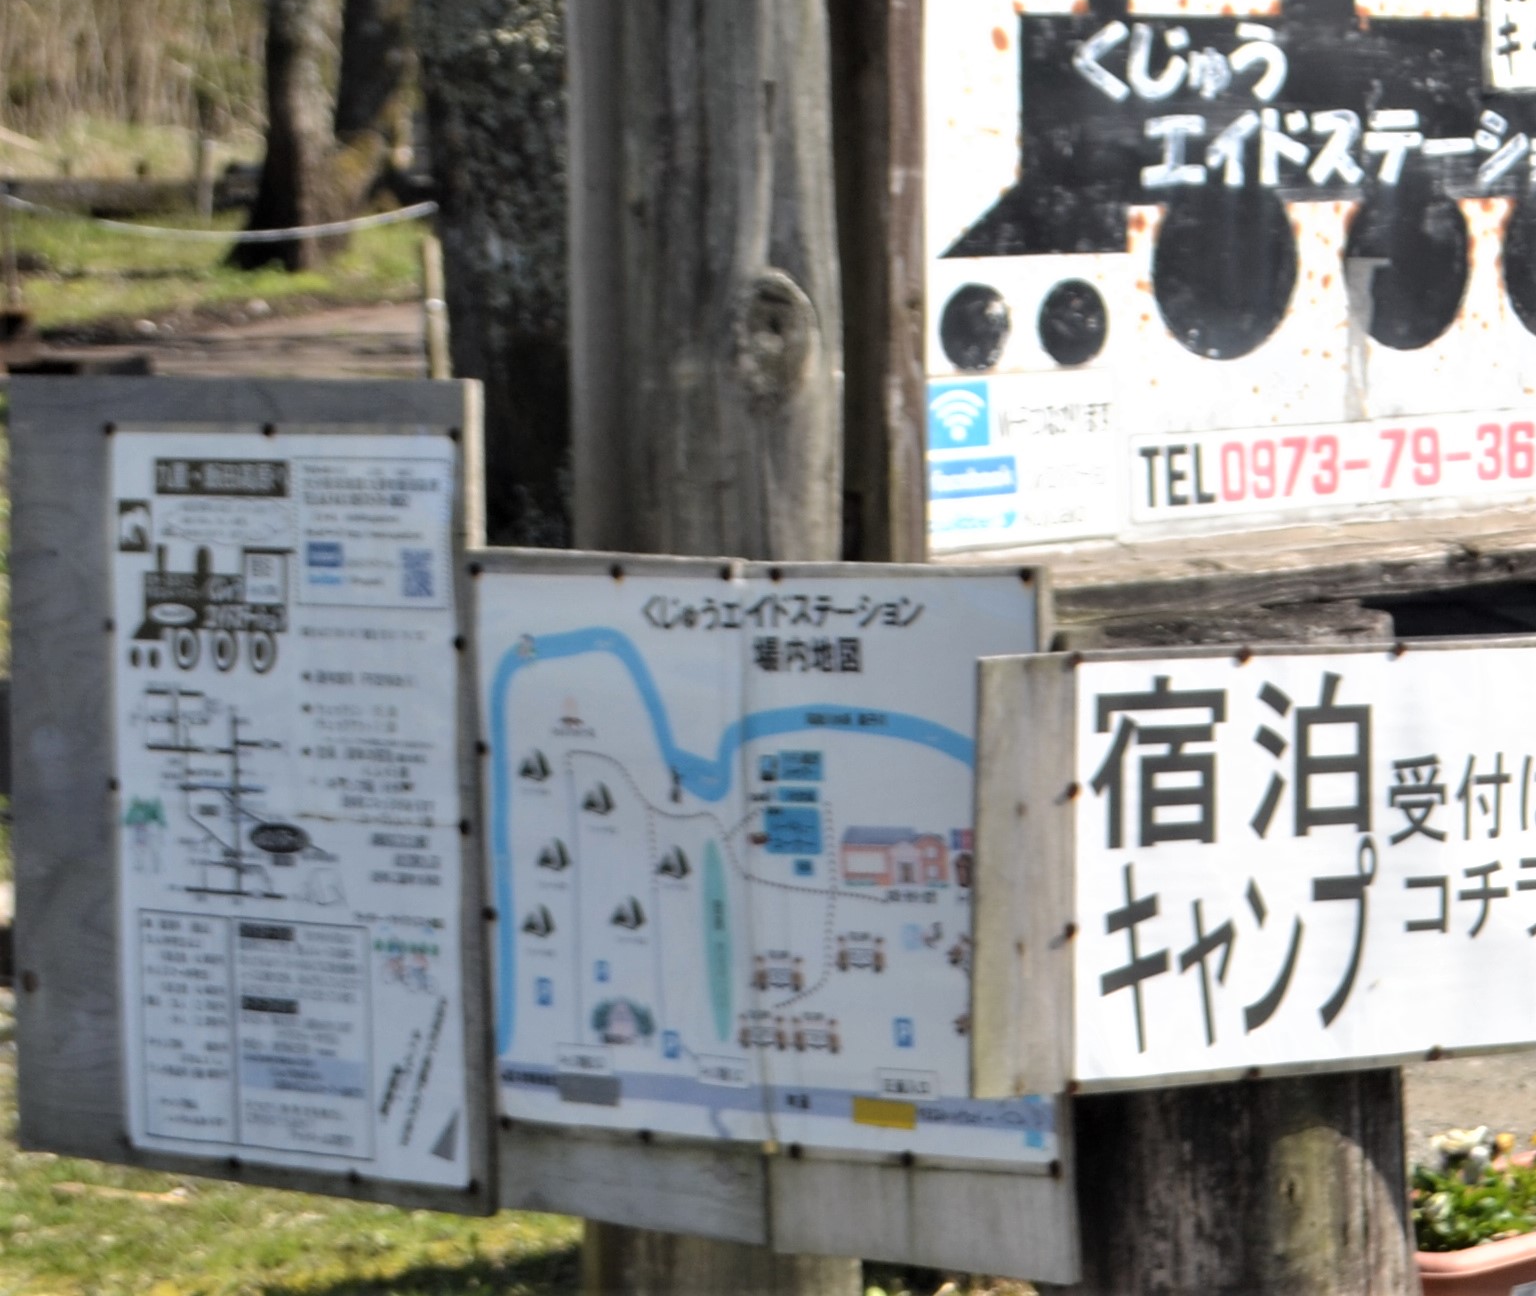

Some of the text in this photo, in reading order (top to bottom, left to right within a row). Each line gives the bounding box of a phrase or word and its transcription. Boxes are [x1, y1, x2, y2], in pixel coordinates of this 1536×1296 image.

[1073, 20, 1288, 102] くじゅう
[643, 594, 926, 631] くじゅうエイドステーション
[753, 635, 863, 673] 場内地図
[1090, 671, 1372, 850] 宿泊
[1100, 833, 1378, 1055] キャンプ
